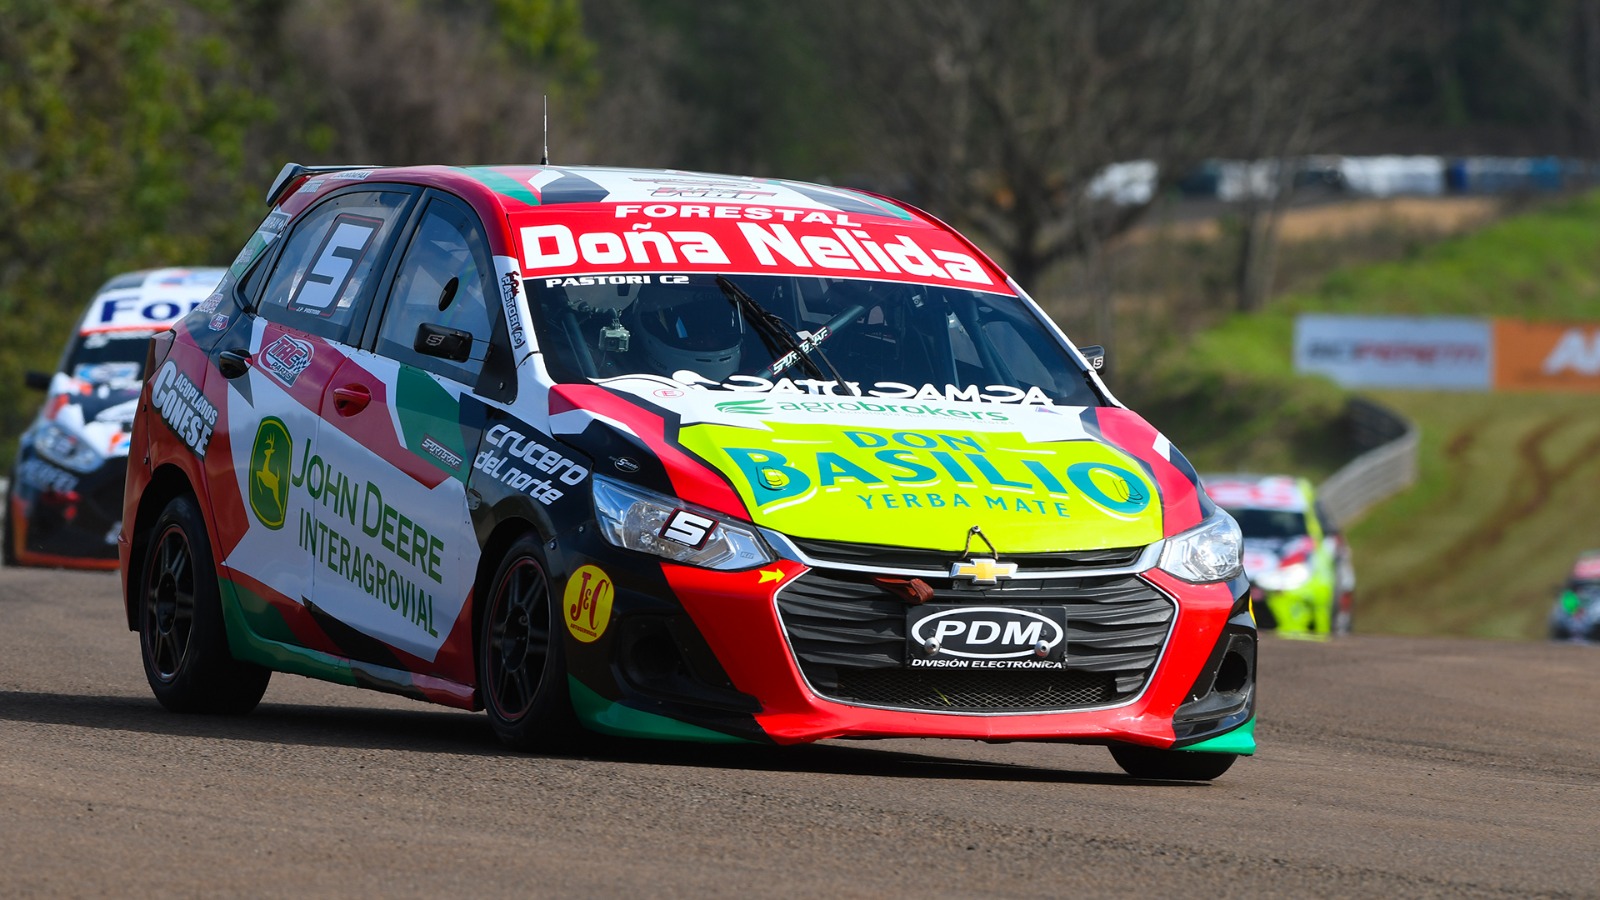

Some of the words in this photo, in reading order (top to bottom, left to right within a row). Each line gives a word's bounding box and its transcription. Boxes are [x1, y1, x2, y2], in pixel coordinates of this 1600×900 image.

[615, 204, 862, 227] FORESTAL
[296, 223, 374, 308] 5
[520, 221, 731, 270] Doña
[735, 222, 995, 285] Nelida
[546, 275, 651, 289] PASTORI
[659, 275, 690, 285] C2
[270, 361, 294, 380] PARTS
[152, 360, 213, 457] CONESE
[174, 372, 219, 426] ACOPLADOS
[776, 400, 1010, 422] agrobrokers
[841, 430, 986, 454] DON
[473, 449, 500, 478] del
[500, 468, 564, 505] norte
[722, 446, 1151, 516] BASILIO
[291, 438, 359, 526] JOHN
[362, 480, 445, 584] DEERE
[856, 492, 971, 511] YERBA
[981, 496, 1071, 519] MATE
[664, 510, 714, 546] 5
[299, 507, 438, 638] INTERAGROVIAL
[934, 620, 1044, 645] PDM
[911, 657, 968, 668] DIVISIÓN
[971, 658, 1063, 669] ELECTRÓNICA
